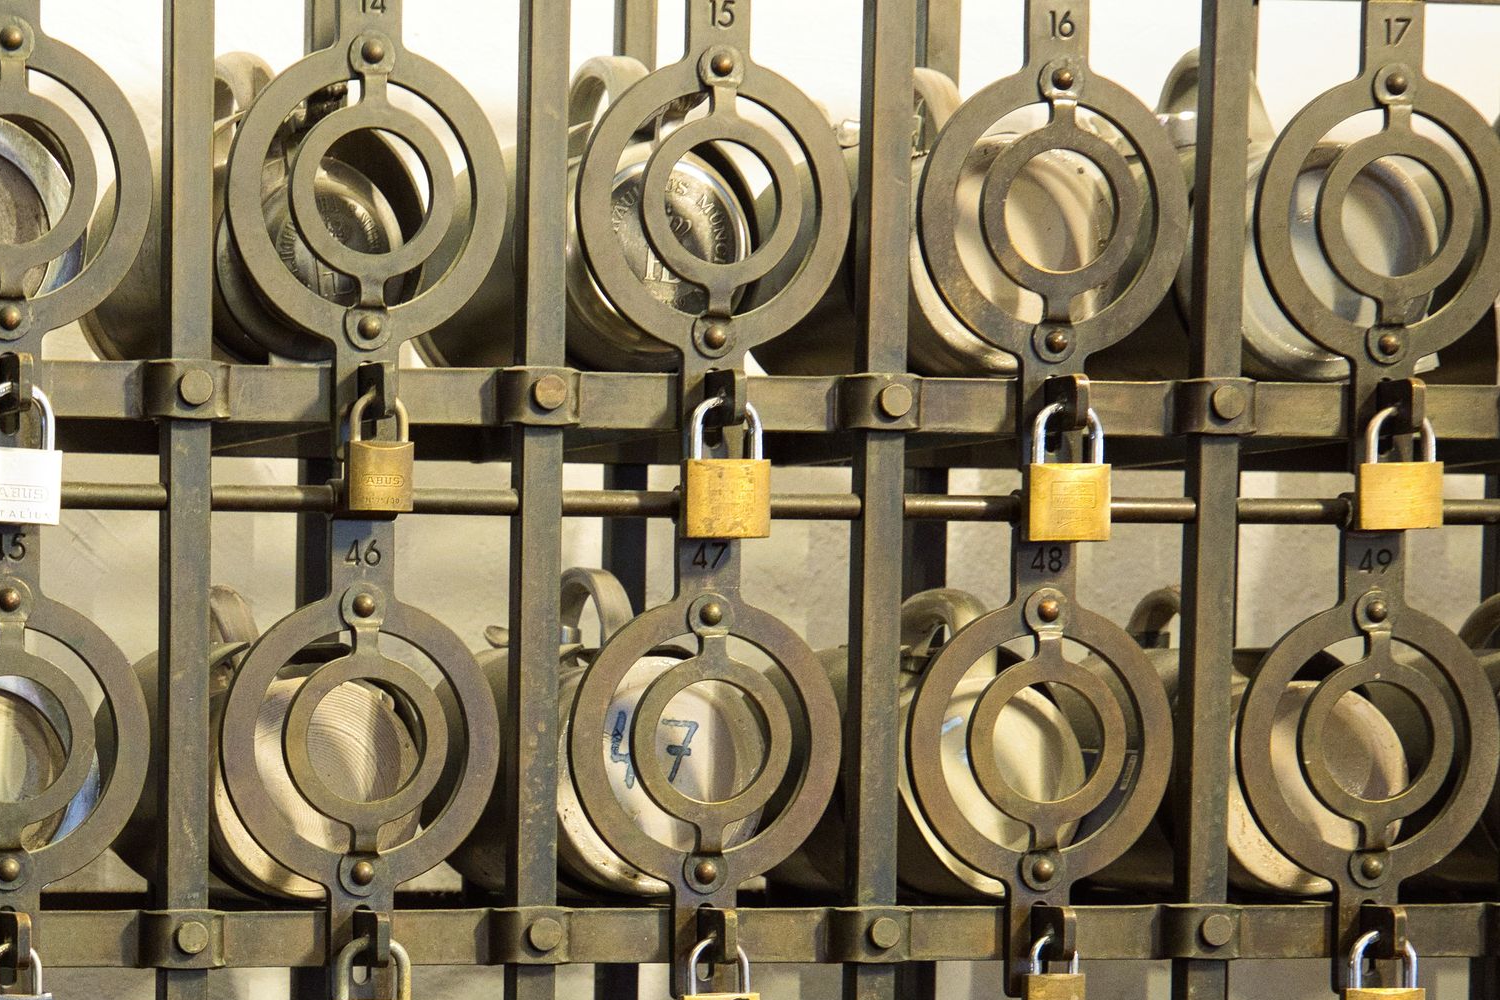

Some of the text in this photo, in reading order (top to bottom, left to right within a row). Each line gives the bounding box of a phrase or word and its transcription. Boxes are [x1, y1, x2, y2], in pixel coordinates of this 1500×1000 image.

[709, 0, 735, 28] 15
[1048, 9, 1076, 39] 16
[1383, 17, 1412, 46] 17
[364, 474, 401, 485] ABUS
[344, 538, 382, 567] 46
[691, 541, 729, 570] 47
[1030, 545, 1063, 574] 48
[1358, 547, 1393, 575] 49
